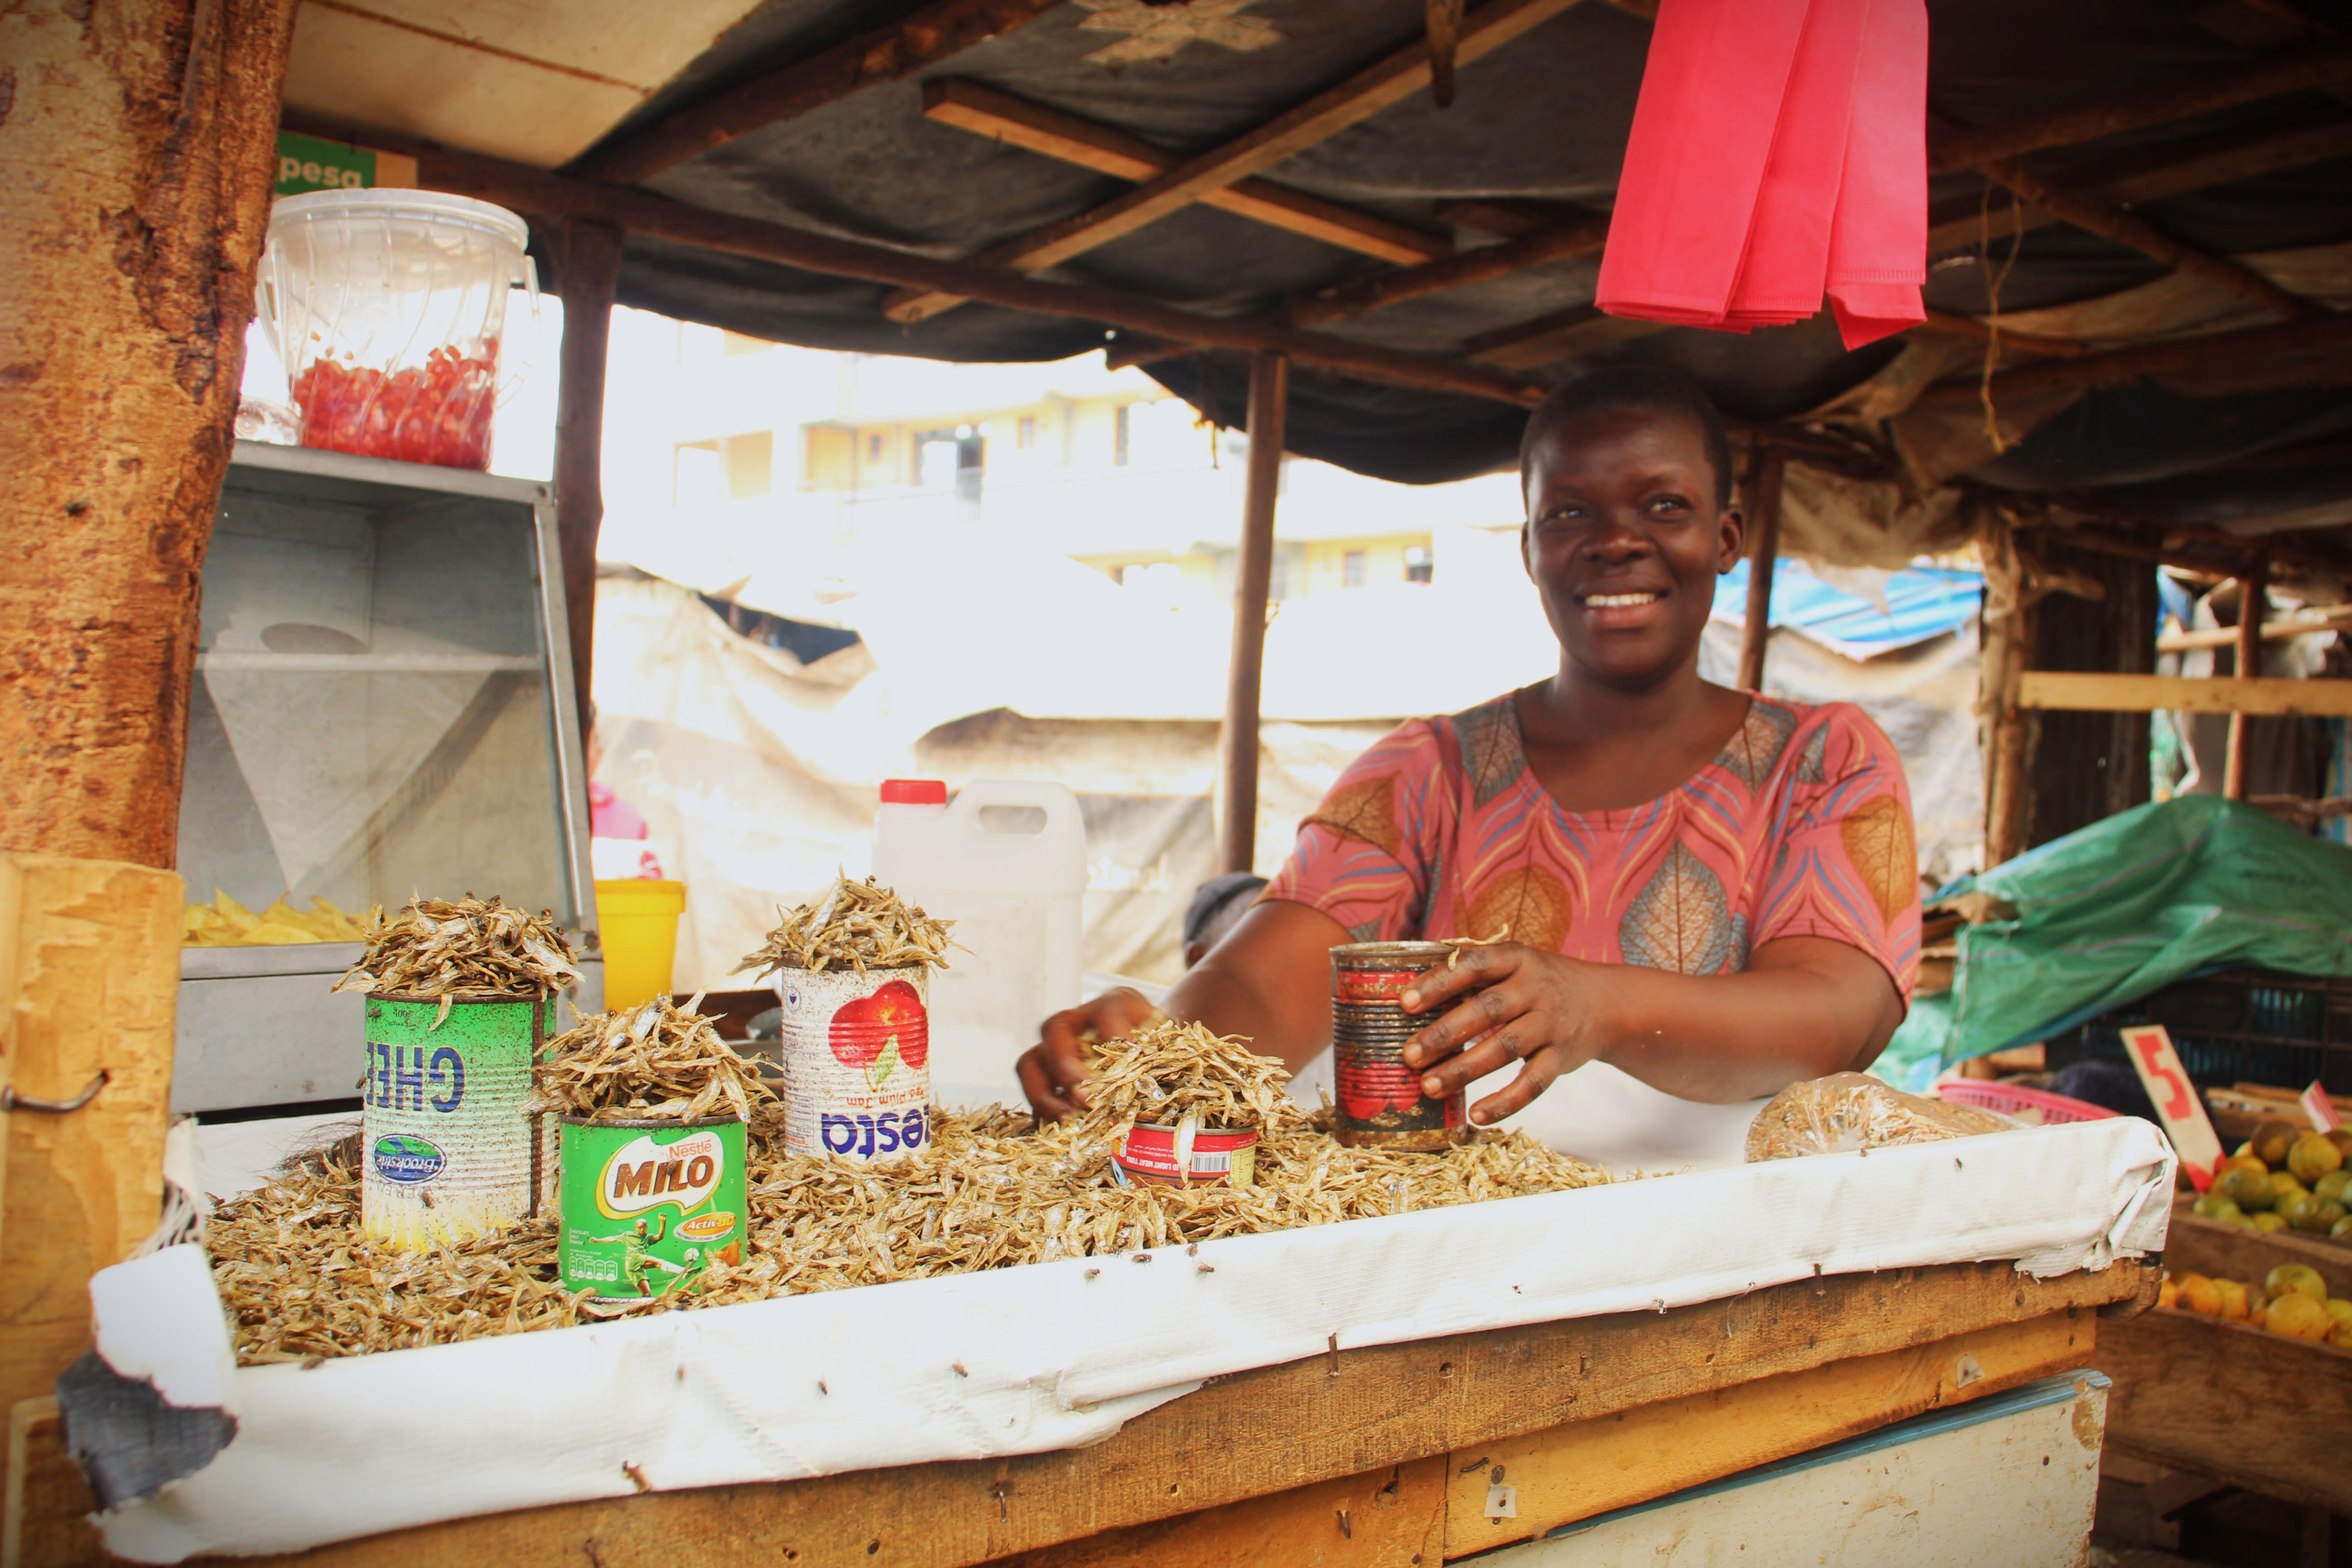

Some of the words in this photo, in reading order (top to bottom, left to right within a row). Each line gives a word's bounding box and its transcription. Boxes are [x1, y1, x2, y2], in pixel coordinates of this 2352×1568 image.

[2135, 1034, 2192, 1121] 5
[847, 1097, 873, 1109] Jam
[668, 1140, 712, 1159] Nestlé
[376, 1155, 436, 1173] Brookside
[1127, 1156, 1138, 1165] TUNA
[1138, 1159, 1153, 1167] MEAT
[1154, 1161, 1171, 1170] LIGHT
[613, 1155, 714, 1198] MILO
